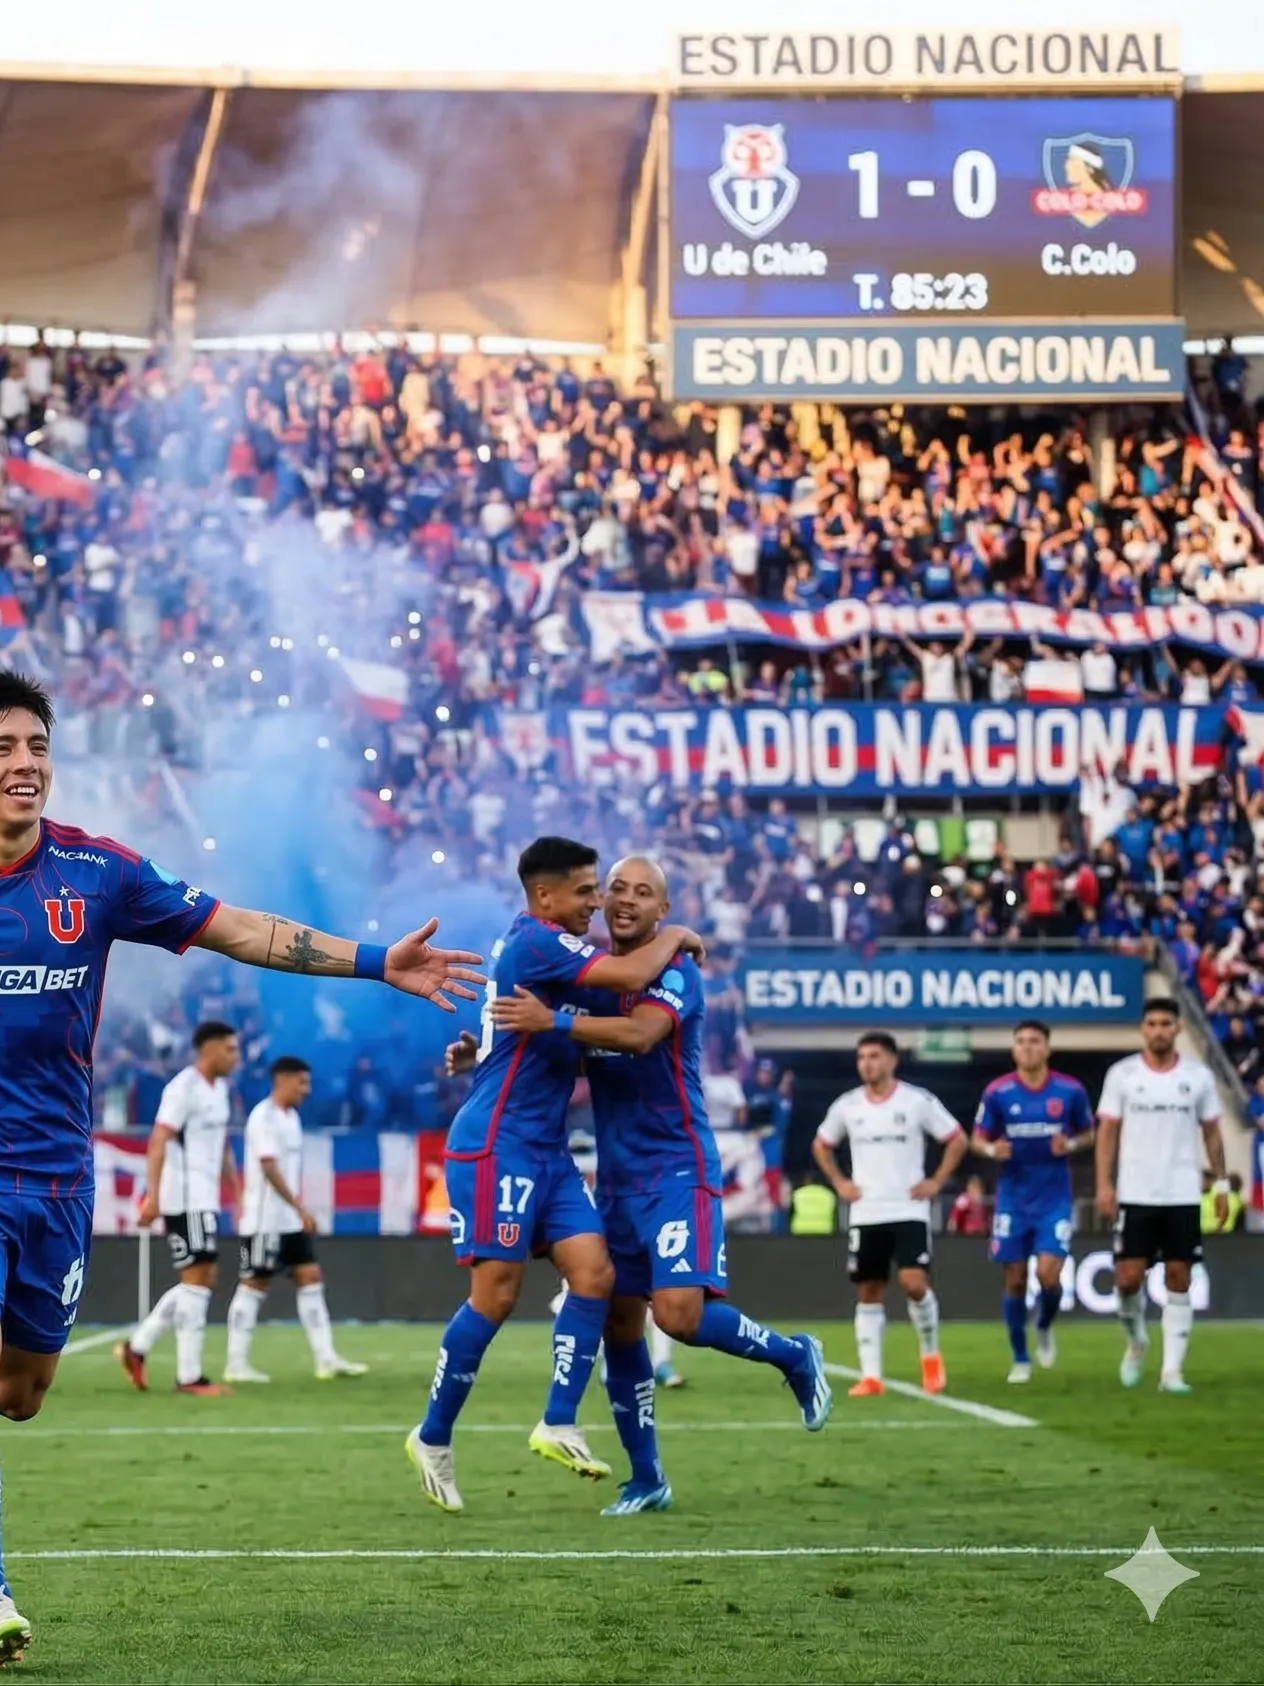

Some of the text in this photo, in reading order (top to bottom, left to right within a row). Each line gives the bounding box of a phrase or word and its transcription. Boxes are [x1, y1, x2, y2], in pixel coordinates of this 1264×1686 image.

[679, 32, 1179, 76] ESTADIO NACIONAL
[848, 150, 879, 219] 1
[952, 150, 997, 219] 0
[682, 241, 828, 276] U de Chile
[890, 272, 989, 310] 85:23
[692, 335, 1171, 386] ESTADIO NACIONAL
[567, 708, 1217, 788] ESTADIO NACIONAL
[44, 899, 86, 944] U
[745, 969, 1127, 1009] ESTADIO NACIONAL
[498, 1175, 535, 1214] 17
